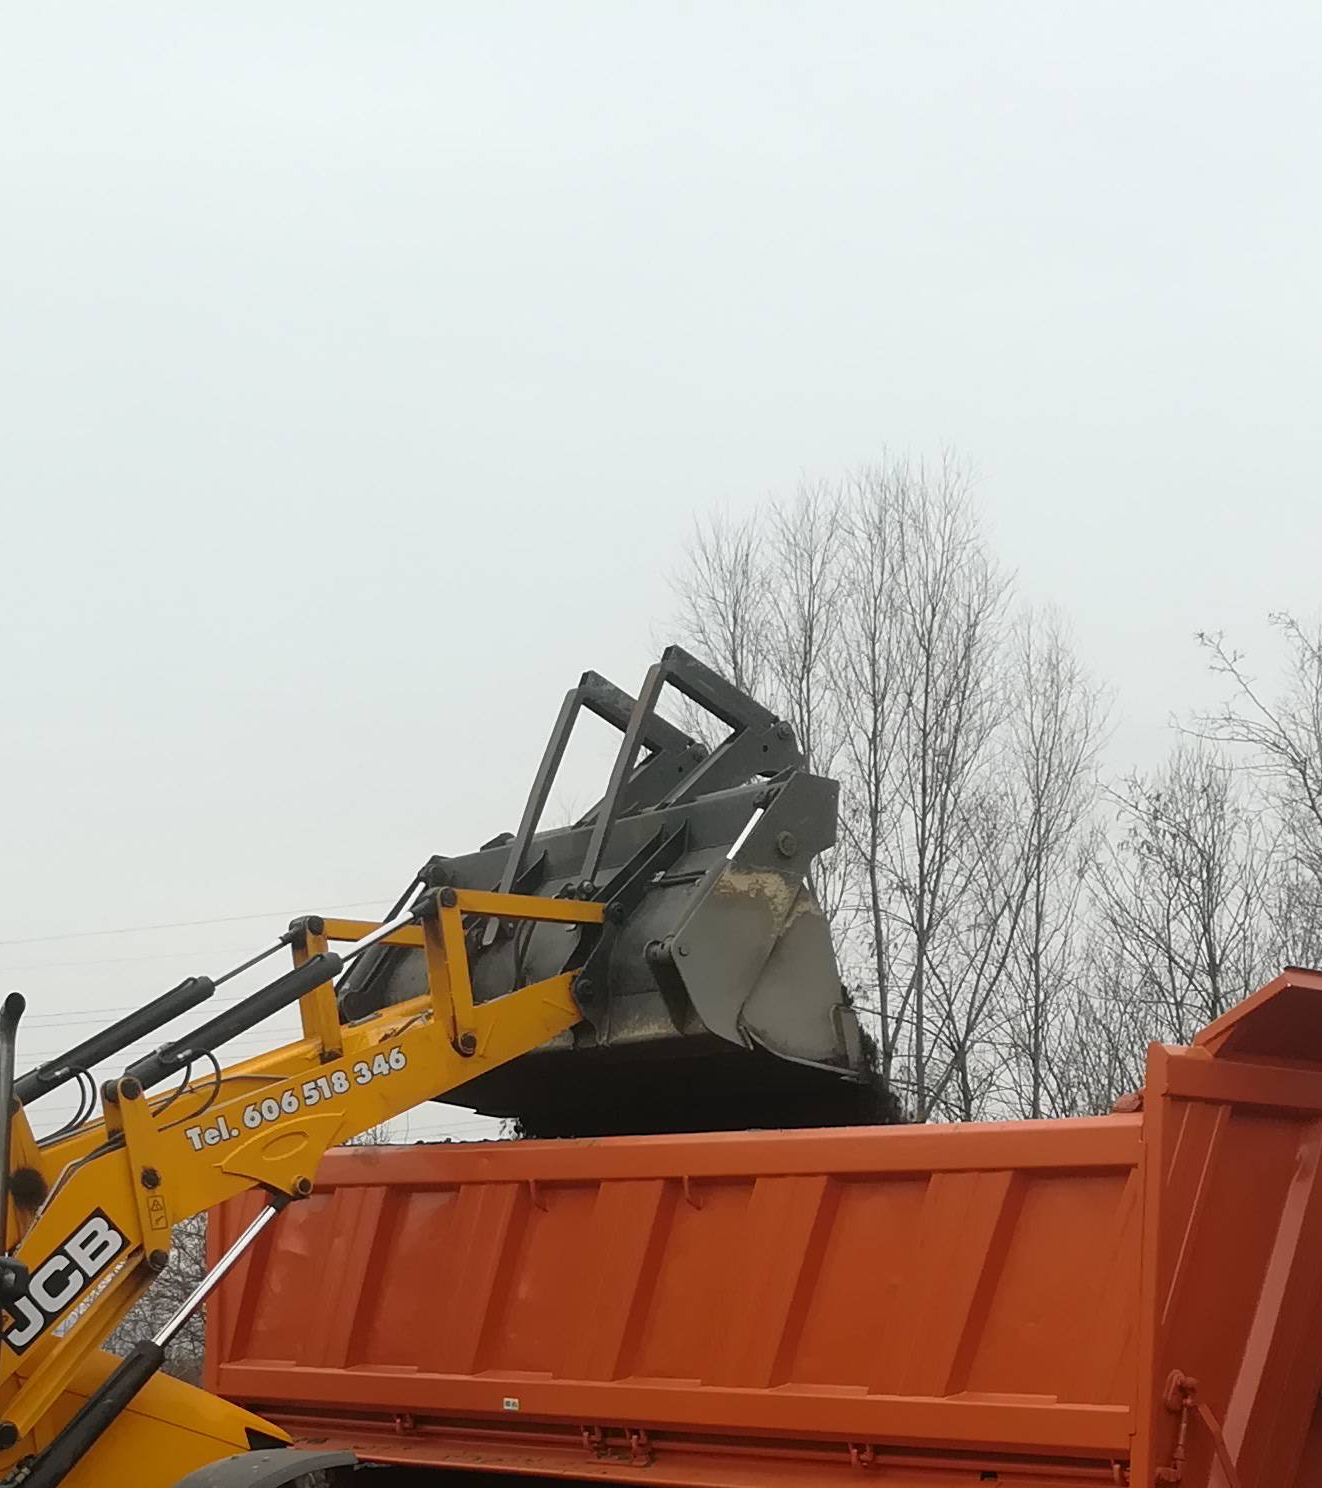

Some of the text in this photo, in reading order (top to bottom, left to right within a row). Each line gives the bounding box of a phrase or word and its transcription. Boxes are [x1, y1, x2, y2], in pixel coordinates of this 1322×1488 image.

[185, 1046, 407, 1151] Tel. 606 518 346
[7, 1216, 123, 1347] JCB
